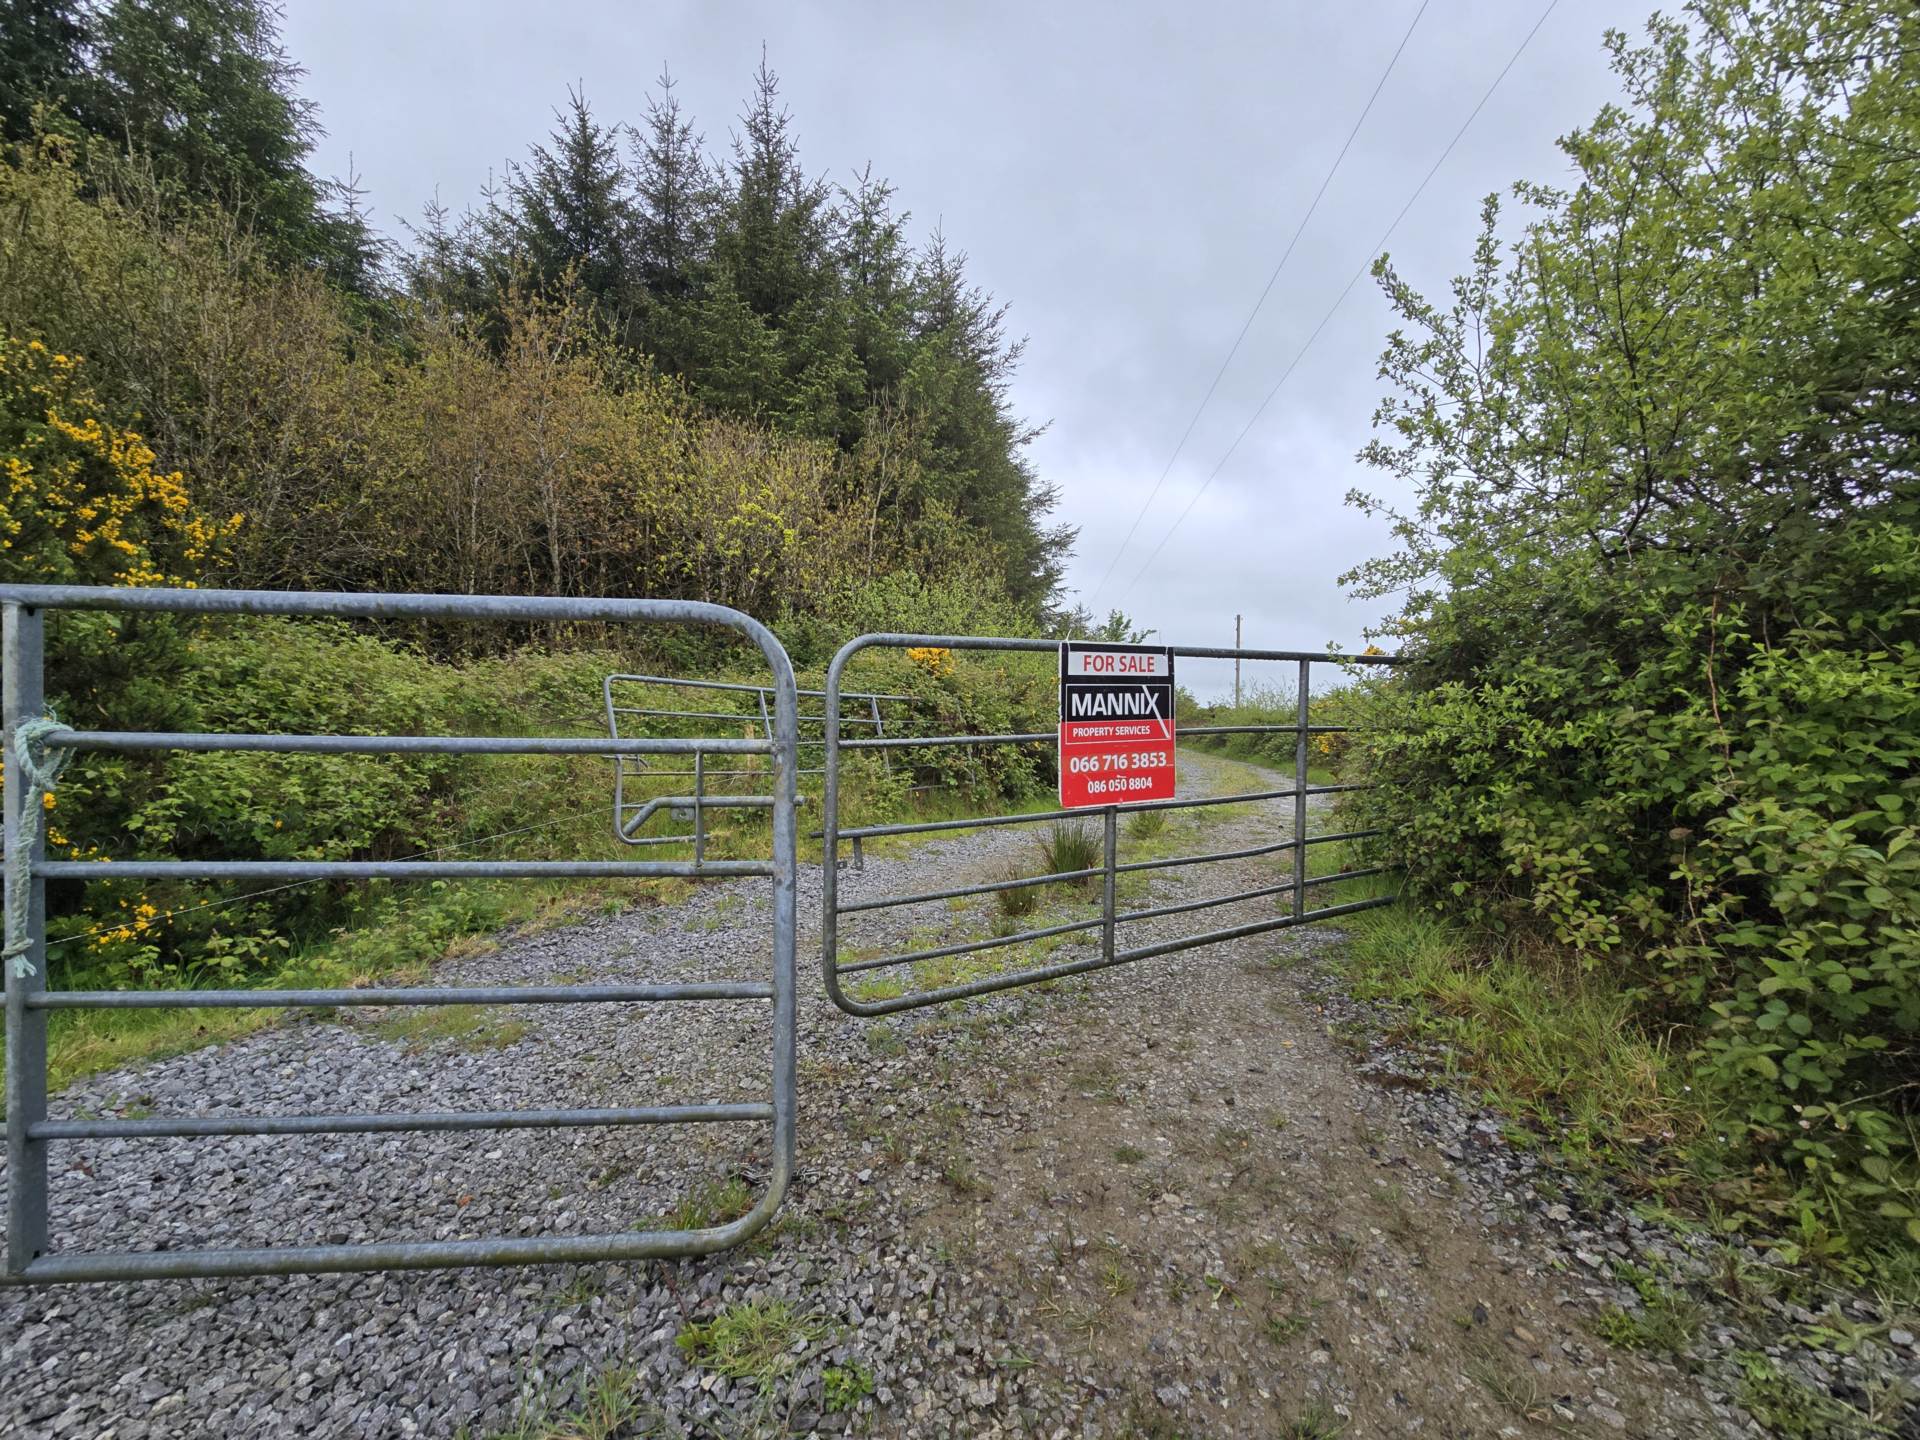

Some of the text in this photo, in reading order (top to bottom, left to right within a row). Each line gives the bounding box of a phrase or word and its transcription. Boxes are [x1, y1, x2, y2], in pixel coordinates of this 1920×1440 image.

[1083, 655, 1155, 673] FOR SALE
[1071, 692, 1160, 716] MANNIX
[1072, 725, 1150, 737] PROPERTY SERVICES
[1070, 752, 1167, 773] 066 716 3853
[1087, 777, 1152, 794] 086 050 8804
